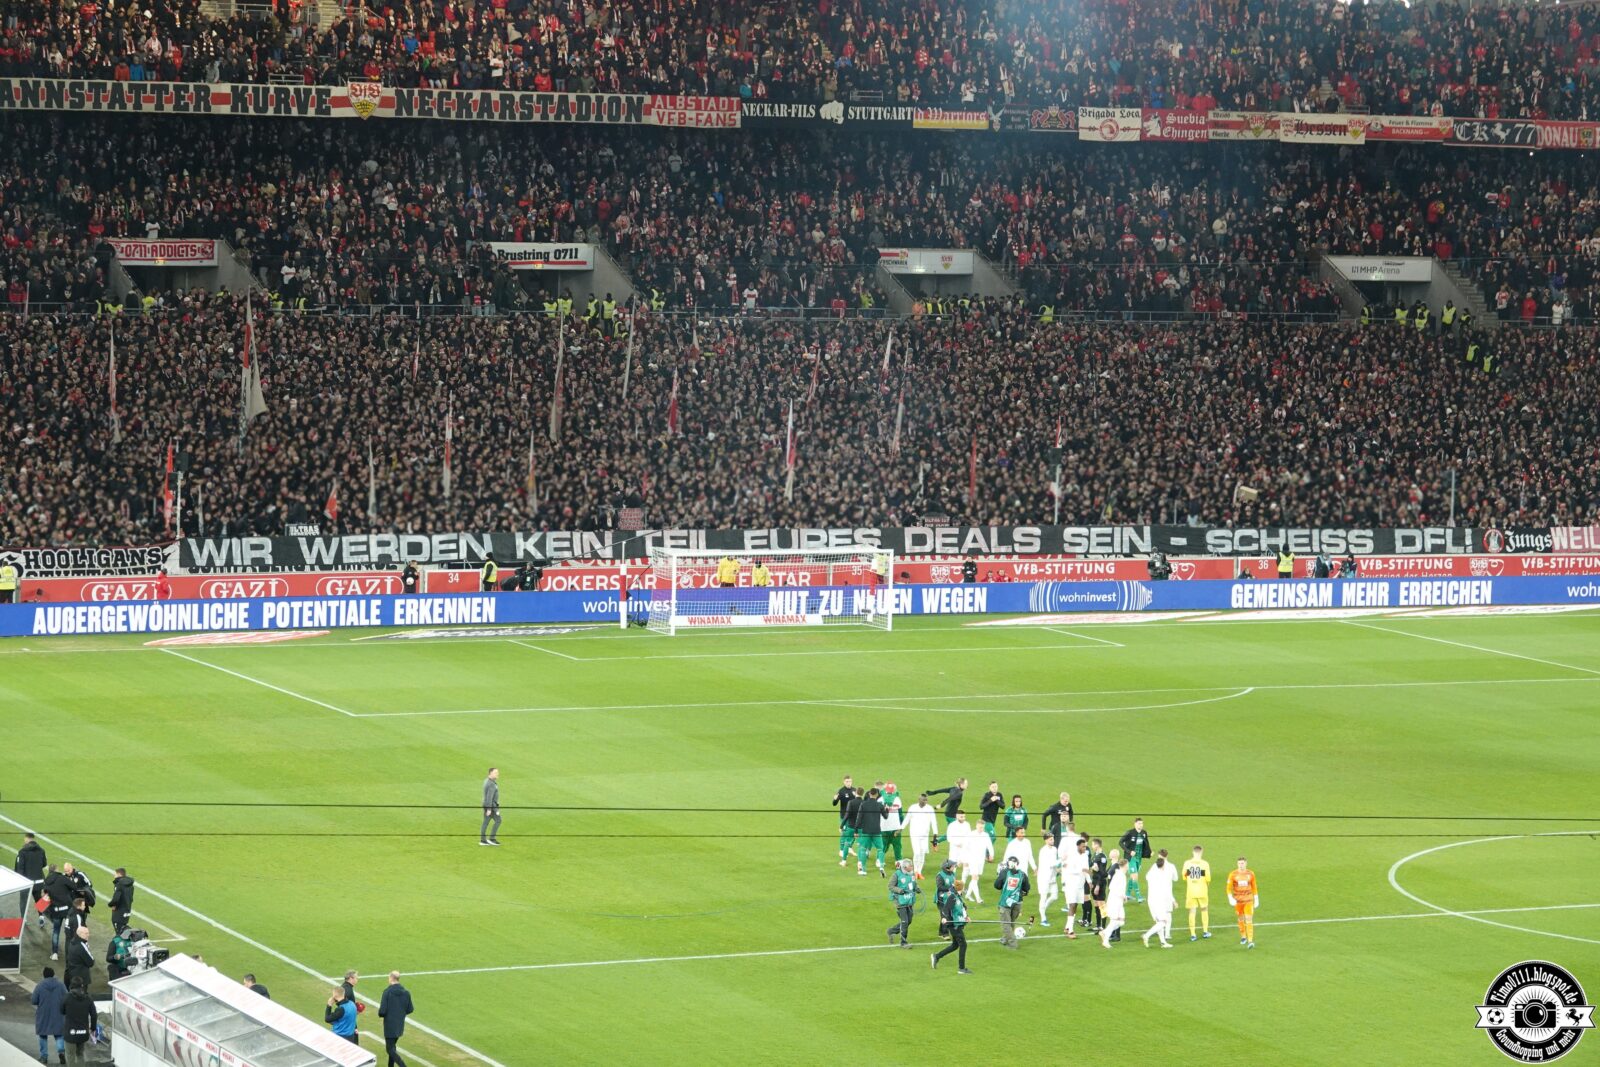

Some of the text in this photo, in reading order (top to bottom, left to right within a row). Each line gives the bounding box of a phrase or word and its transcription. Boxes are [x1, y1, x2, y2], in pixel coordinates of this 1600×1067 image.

[0, 79, 331, 116] ANNSTATTER KURVE
[395, 89, 644, 122] NECKARSTADION
[655, 97, 739, 111] ALBSTADT
[656, 110, 737, 127] VFB-FANS
[742, 102, 913, 120] NECKAR-FILS STUTTGART
[927, 106, 987, 124] Warriors
[1536, 125, 1579, 148] DONAU
[151, 244, 198, 258] ADDICTS
[497, 248, 579, 262] Brustring 0711
[1378, 265, 1401, 274] Arena
[188, 537, 273, 566] WIR
[297, 532, 494, 565] WERDEN
[515, 530, 614, 560] KEIN
[904, 526, 1042, 553] DEALS
[1063, 525, 1151, 553] SEIN
[1169, 536, 1188, 546] -
[1205, 528, 1374, 554] SCHEISS
[1394, 527, 1473, 554] DFL!
[1504, 528, 1552, 552] Jungs
[22, 547, 163, 570] HOOLIGANS
[1257, 559, 1269, 570] 36
[1360, 558, 1454, 570] VfB-STIFTUNG
[851, 565, 863, 576] 35
[1013, 562, 1116, 575] VfB-STIFTUNG
[447, 572, 460, 584] 34
[542, 574, 658, 591] JOKERSTAR
[698, 570, 811, 589] JOESTAR
[768, 591, 810, 616] MUT
[819, 590, 844, 615] ZU
[922, 586, 988, 614] WEGEN
[1059, 592, 1117, 603] wohninvest
[1231, 580, 1493, 609] GEMEINSAM MEHR ERREICHEN
[262, 599, 382, 629] POTENTIALE
[394, 597, 497, 625] ERKENNEN
[688, 616, 732, 625] WINAMAX
[763, 614, 807, 624] WINAMAX
